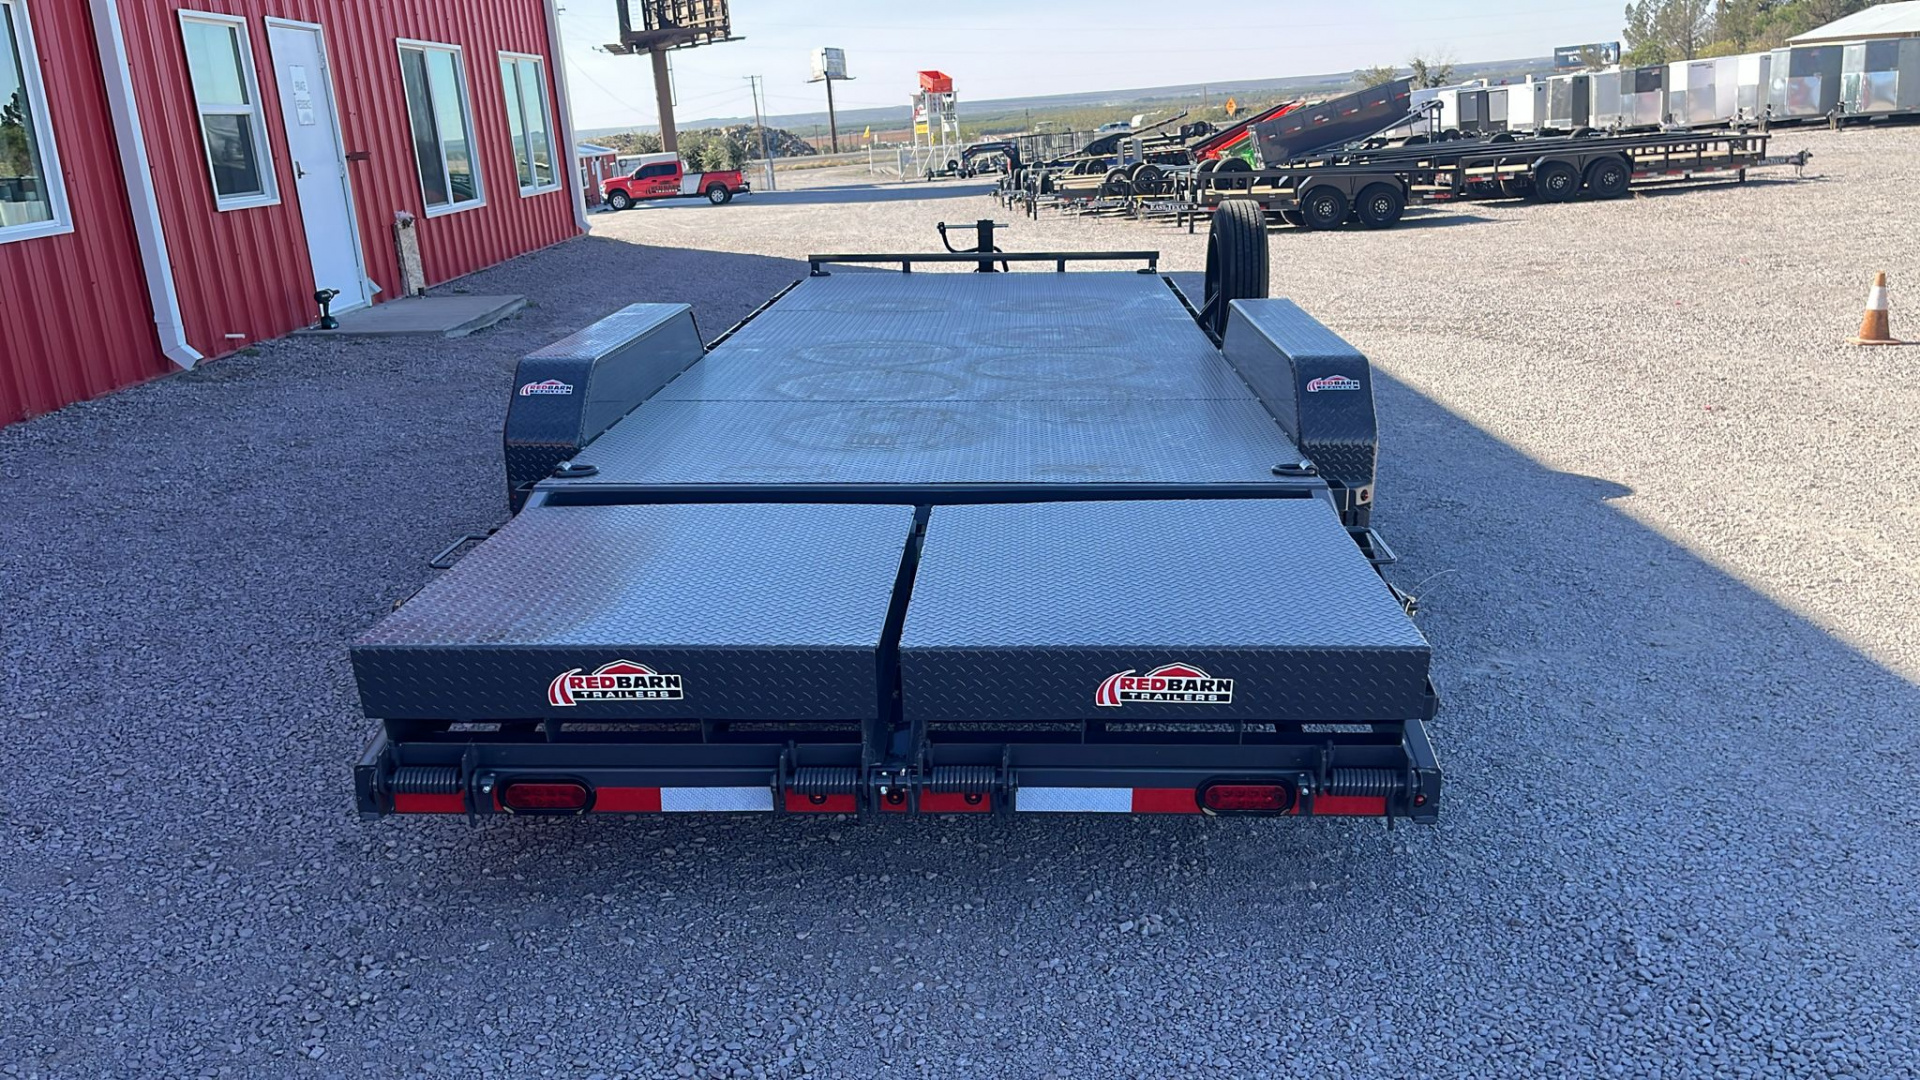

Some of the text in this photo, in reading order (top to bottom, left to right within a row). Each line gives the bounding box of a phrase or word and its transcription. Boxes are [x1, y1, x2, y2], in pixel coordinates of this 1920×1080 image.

[1166, 203, 1188, 211] TEXAS
[569, 676, 680, 689] REDBARN
[1120, 678, 1231, 692] REDBARN
[1129, 692, 1218, 701] TRAILERS
